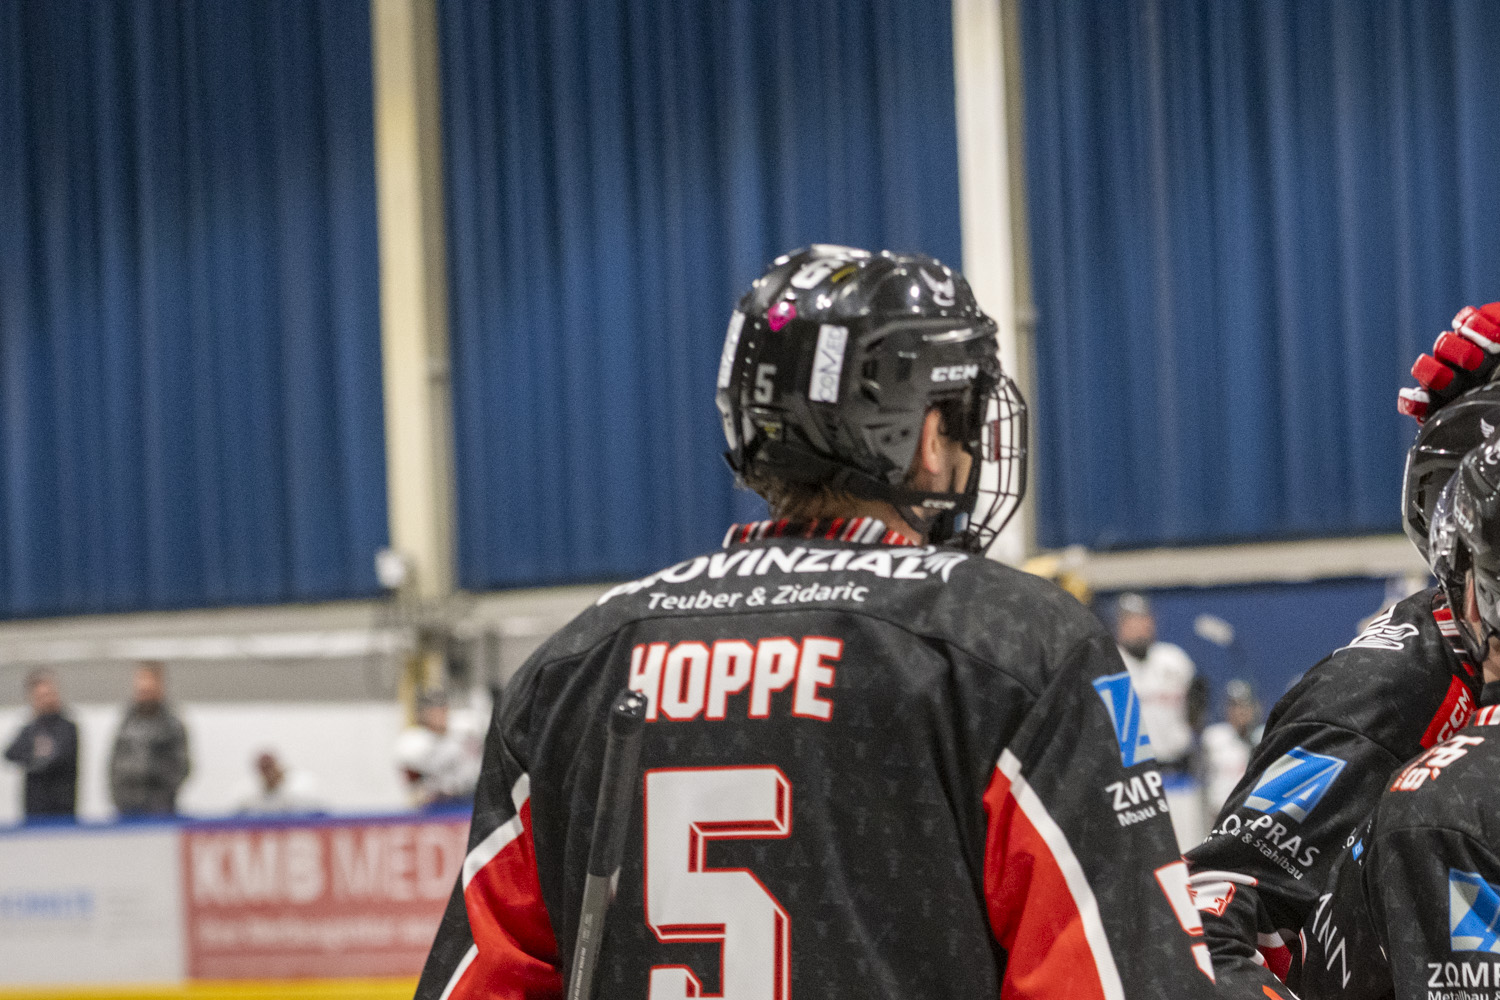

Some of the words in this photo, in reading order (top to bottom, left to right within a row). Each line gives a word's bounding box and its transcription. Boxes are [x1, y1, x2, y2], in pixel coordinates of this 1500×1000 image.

[931, 364, 978, 382] CCM
[648, 591, 743, 611] Teuber
[746, 588, 765, 606] &
[770, 582, 870, 604] Zidaric
[629, 635, 844, 722] HOPPE
[1437, 687, 1471, 743] CCM
[1252, 838, 1304, 881] Stahlbau
